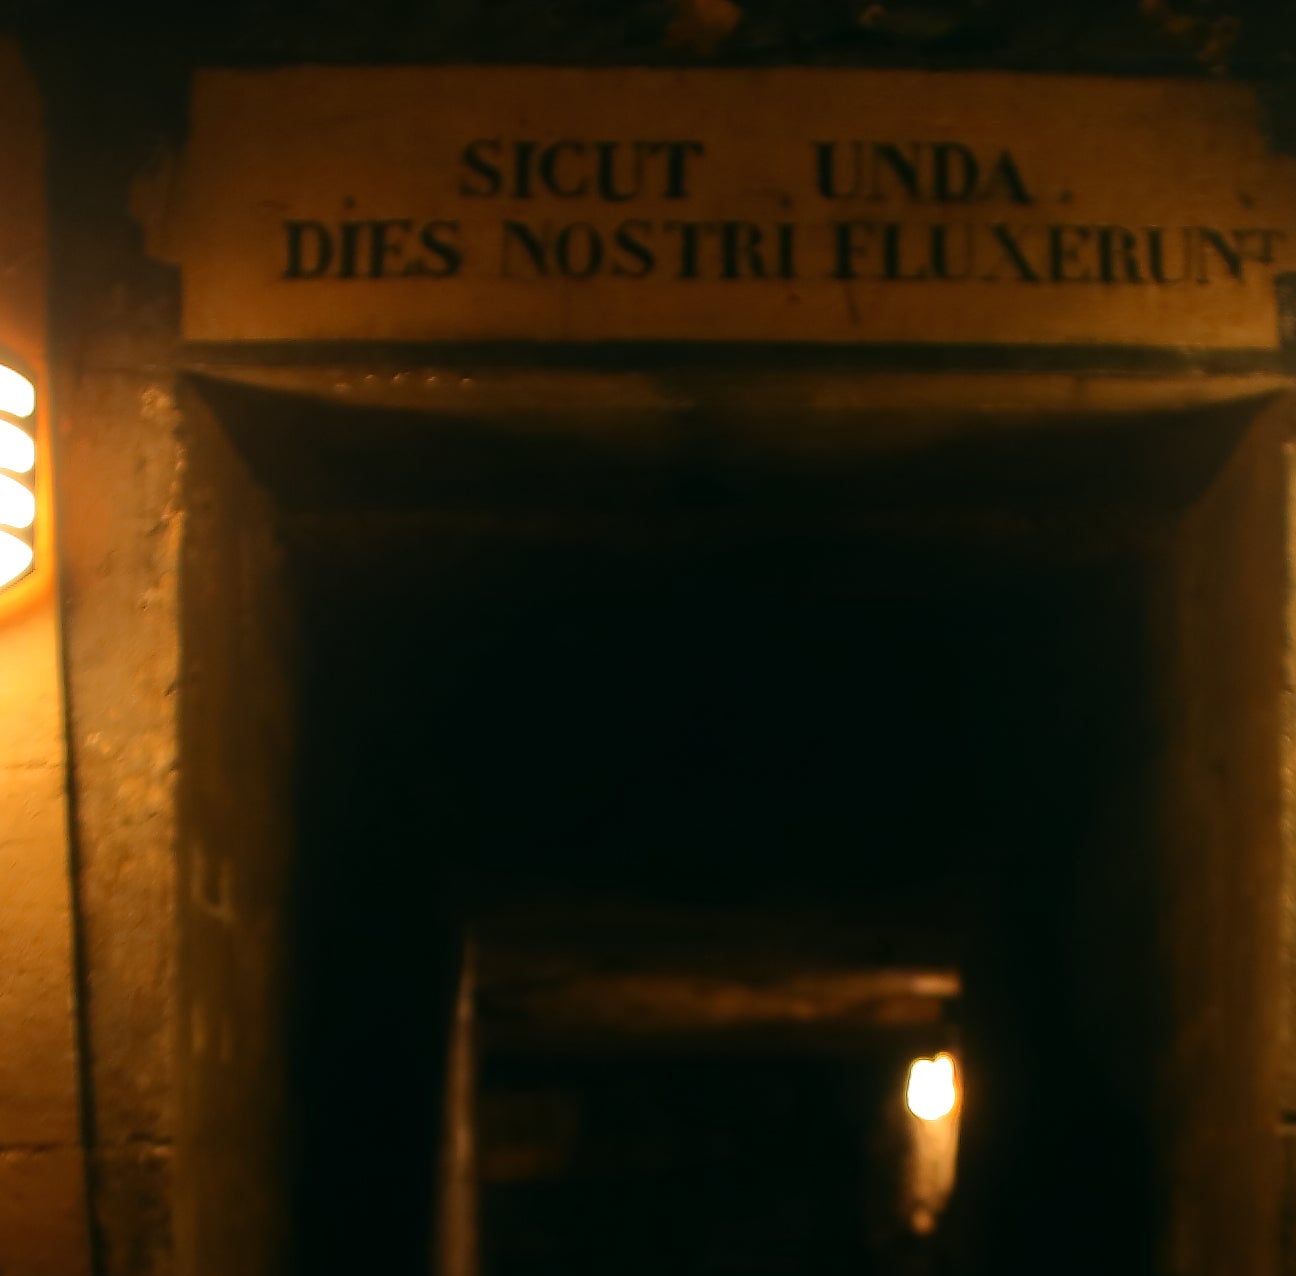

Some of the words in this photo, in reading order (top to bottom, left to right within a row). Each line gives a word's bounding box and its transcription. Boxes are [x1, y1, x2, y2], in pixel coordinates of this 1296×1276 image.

[458, 138, 705, 201] SICUT
[282, 217, 463, 281] DIES
[504, 216, 797, 281] NOSTRI
[831, 219, 1288, 284] FLUXERUNT
